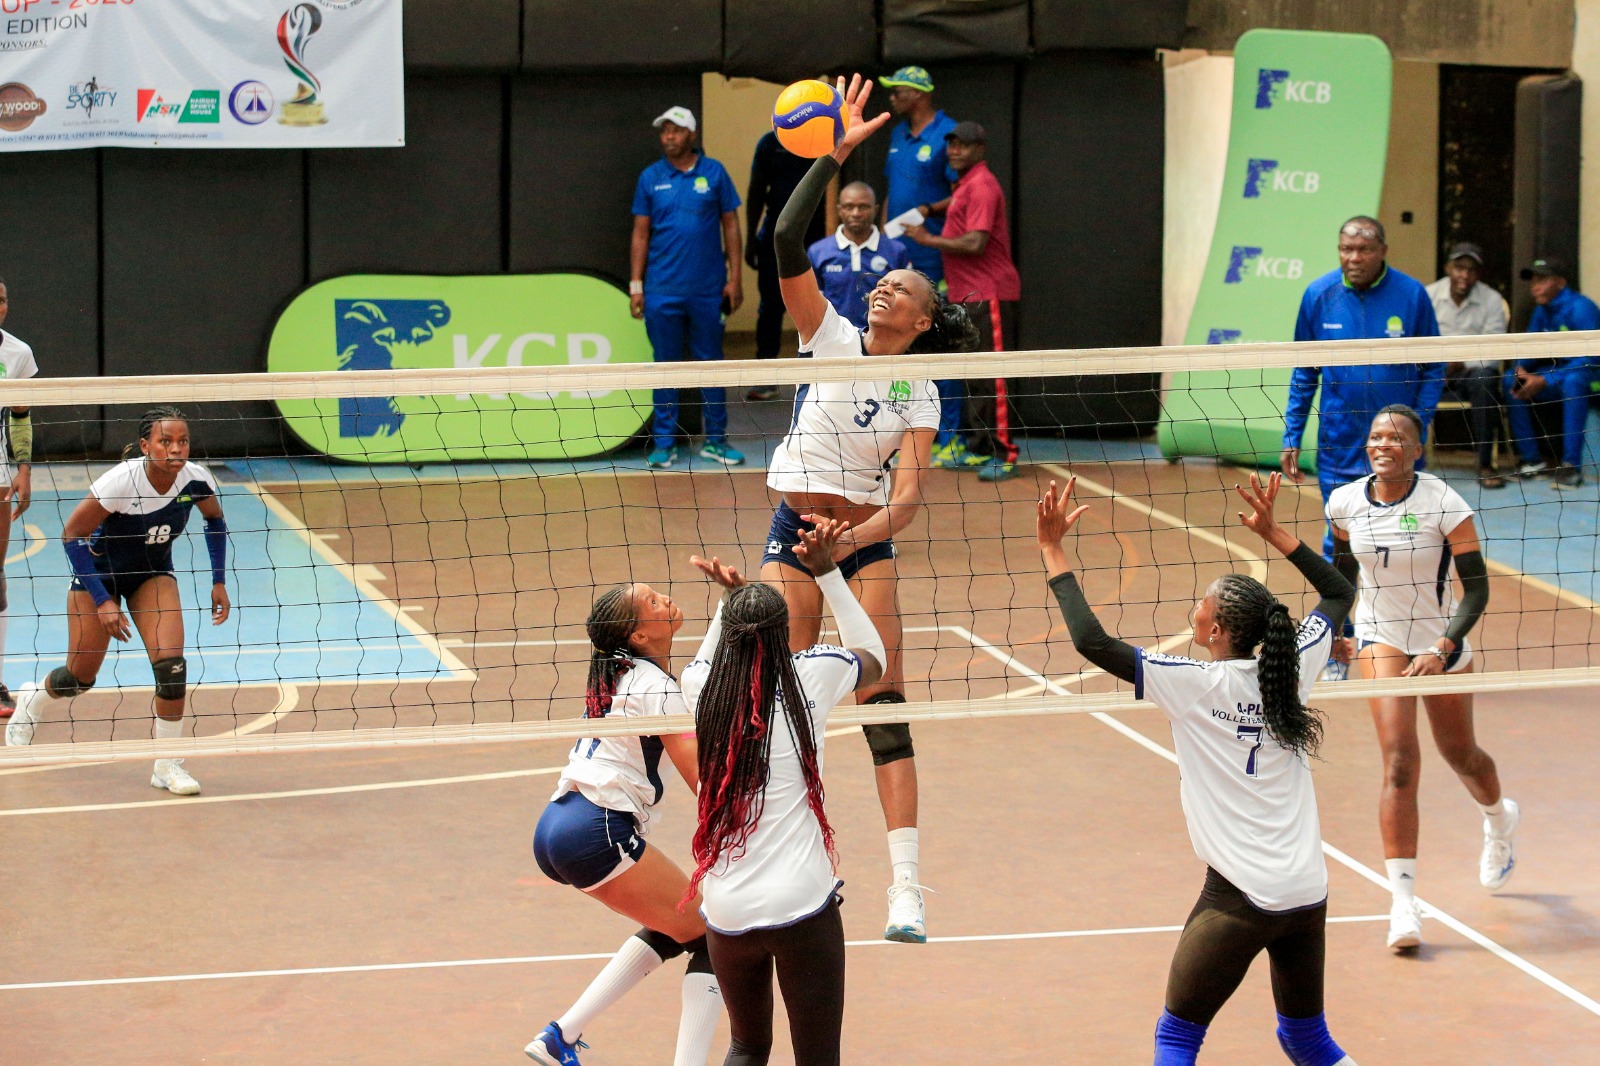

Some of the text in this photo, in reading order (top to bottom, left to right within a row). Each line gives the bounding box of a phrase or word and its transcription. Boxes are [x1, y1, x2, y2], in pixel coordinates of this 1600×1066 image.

[7, 13, 88, 34] EDITION
[1285, 80, 1331, 104] KCB
[1273, 169, 1320, 193] KCB
[1256, 256, 1304, 279] KCB
[453, 332, 612, 401] KCB
[890, 390, 908, 400] KCB
[854, 399, 880, 428] 3
[145, 524, 171, 545] 18
[1376, 546, 1390, 568] 7
[1212, 708, 1267, 725] VOLLEYBA
[1237, 702, 1263, 716] A-PL
[1237, 725, 1264, 778] 7
